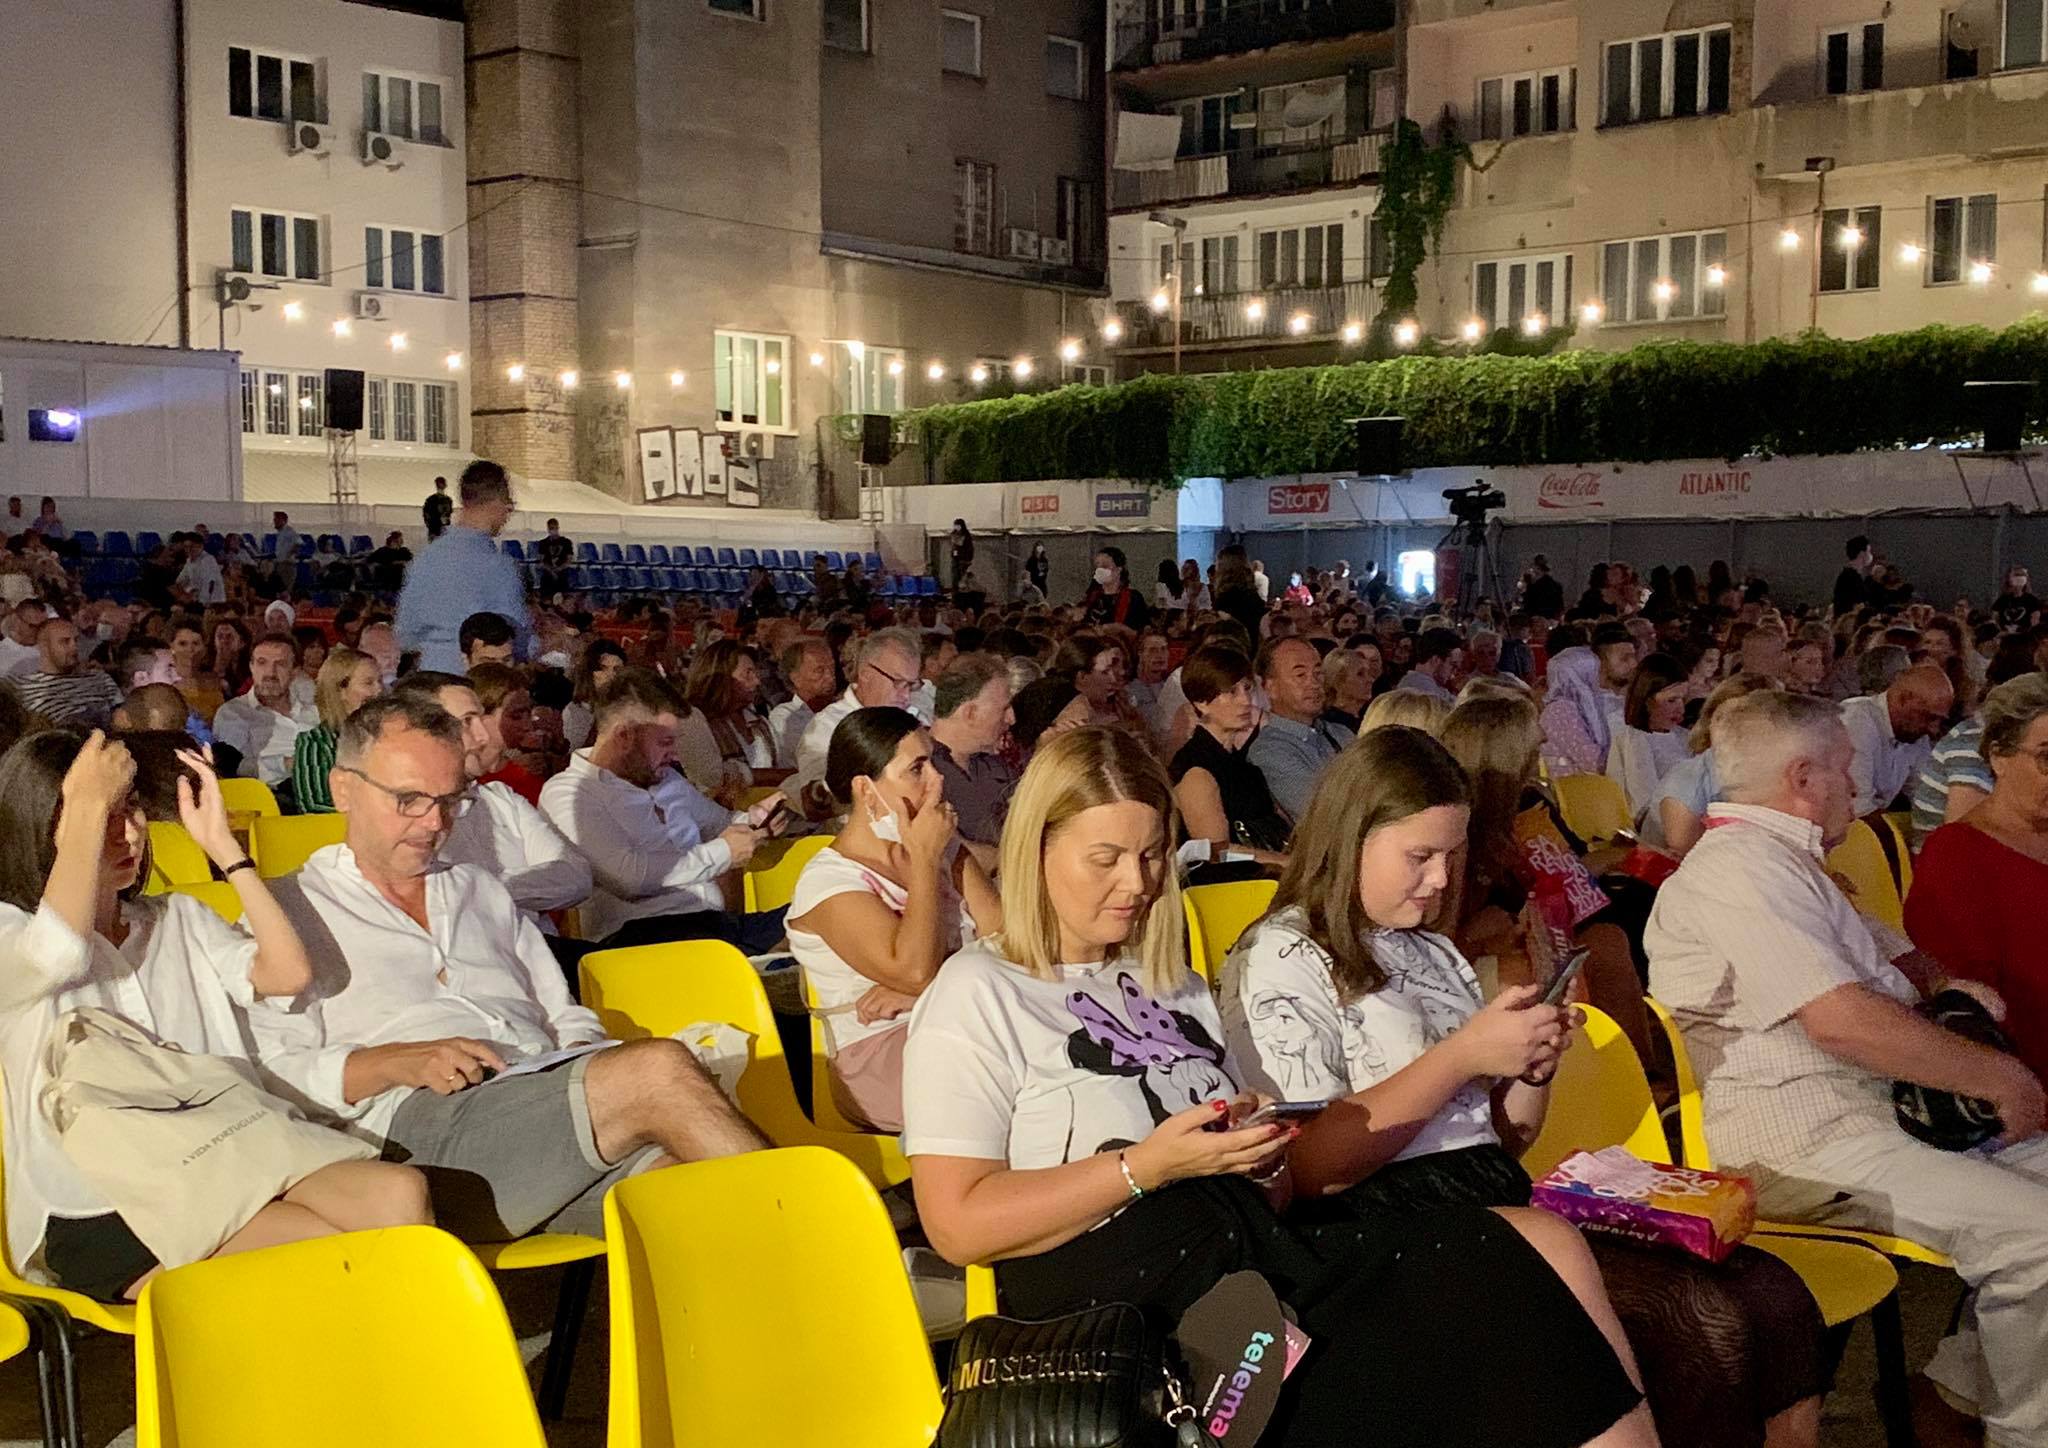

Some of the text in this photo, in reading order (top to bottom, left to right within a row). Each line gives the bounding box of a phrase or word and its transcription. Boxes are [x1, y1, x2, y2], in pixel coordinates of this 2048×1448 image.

[1680, 472, 1752, 494] ATLANTIC
[1099, 499, 1144, 512] BHRT
[1269, 487, 1329, 512] Story
[187, 1143, 211, 1160] VIDA
[959, 1351, 1107, 1391] MOSCHINO
